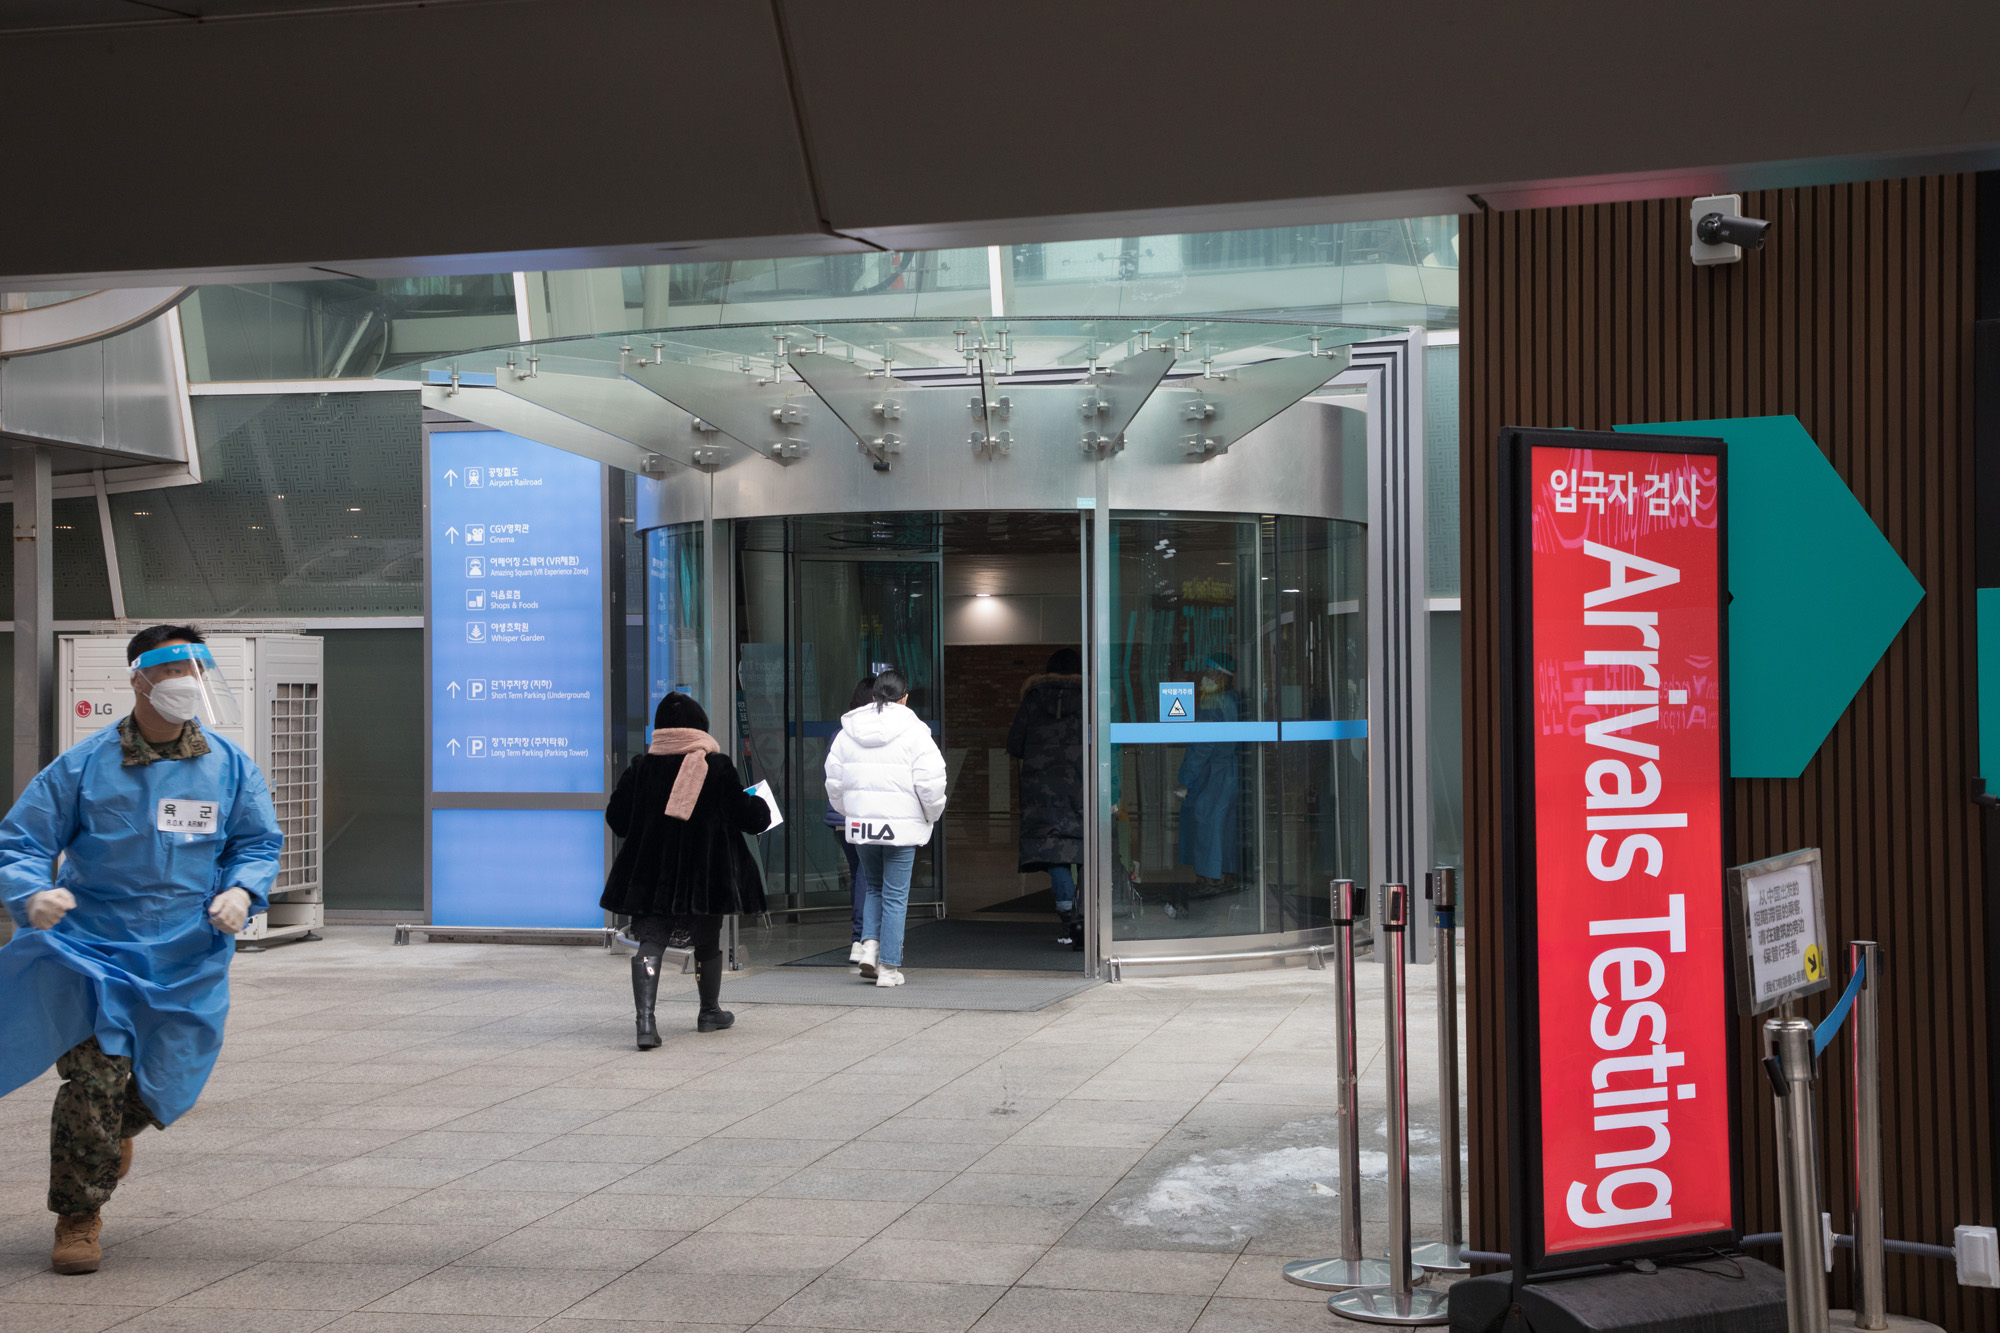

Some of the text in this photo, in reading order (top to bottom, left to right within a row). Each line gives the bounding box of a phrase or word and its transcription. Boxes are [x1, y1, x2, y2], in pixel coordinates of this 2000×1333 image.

[488, 467, 519, 478] 공항철도
[489, 478, 543, 488] Airport Railroad
[1550, 469, 1701, 518] 입국자 검사
[490, 524, 529, 534] CGV영화관
[490, 536, 515, 544] Cinema
[490, 568, 514, 578] Amazing
[514, 568, 533, 578] Square
[544, 567, 573, 577] Experience
[573, 567, 589, 576] Zone)
[490, 601, 510, 610] Shops
[519, 600, 539, 609] Foods
[491, 633, 545, 643] Whisper Garden
[472, 682, 483, 698] P
[491, 679, 552, 690] 단기주차장 (지하)
[491, 691, 507, 699] Short
[524, 691, 546, 700] Parking
[547, 690, 590, 700] (Underground)
[95, 703, 112, 715] LG
[1583, 539, 1688, 882] Arrivals
[472, 740, 483, 755] P
[491, 737, 529, 748] 장기주차장
[491, 750, 505, 758] Long
[522, 749, 543, 758] Parking
[544, 749, 568, 758] (Parking
[569, 749, 589, 757] Tower)
[164, 804, 212, 818] 육 군
[851, 822, 895, 840] FILA
[1758, 880, 1799, 906] 从中国出发的
[1566, 893, 1697, 1229] Testing
